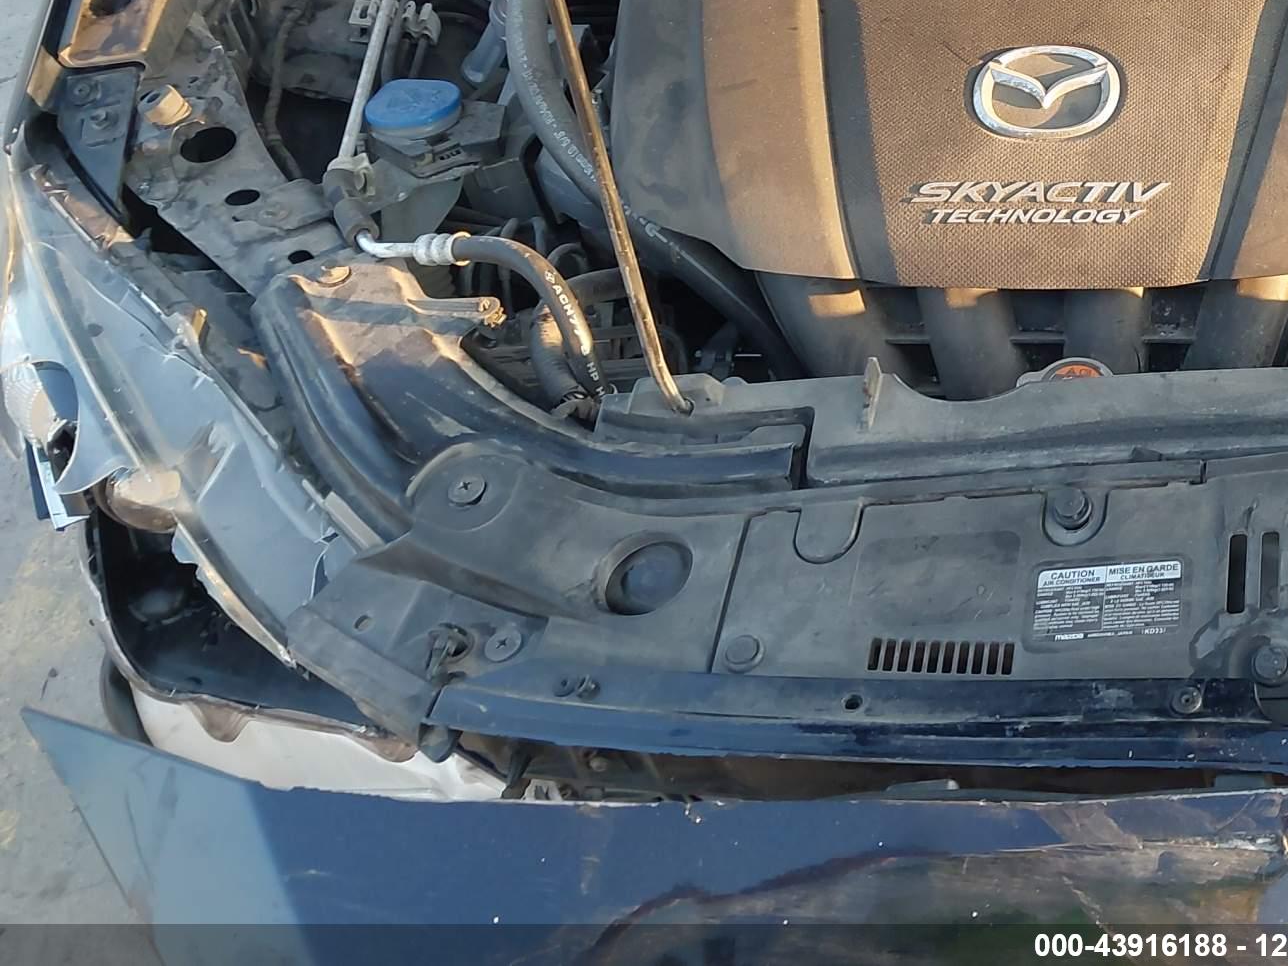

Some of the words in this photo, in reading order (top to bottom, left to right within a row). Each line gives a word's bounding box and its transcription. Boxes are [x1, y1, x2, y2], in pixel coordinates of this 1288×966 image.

[910, 180, 1172, 204] SKYACTIV
[930, 207, 1146, 225] TECHNOLOGY
[1050, 569, 1096, 580] CAUTION
[1108, 566, 1131, 576] MISE
[1132, 565, 1145, 574] EN
